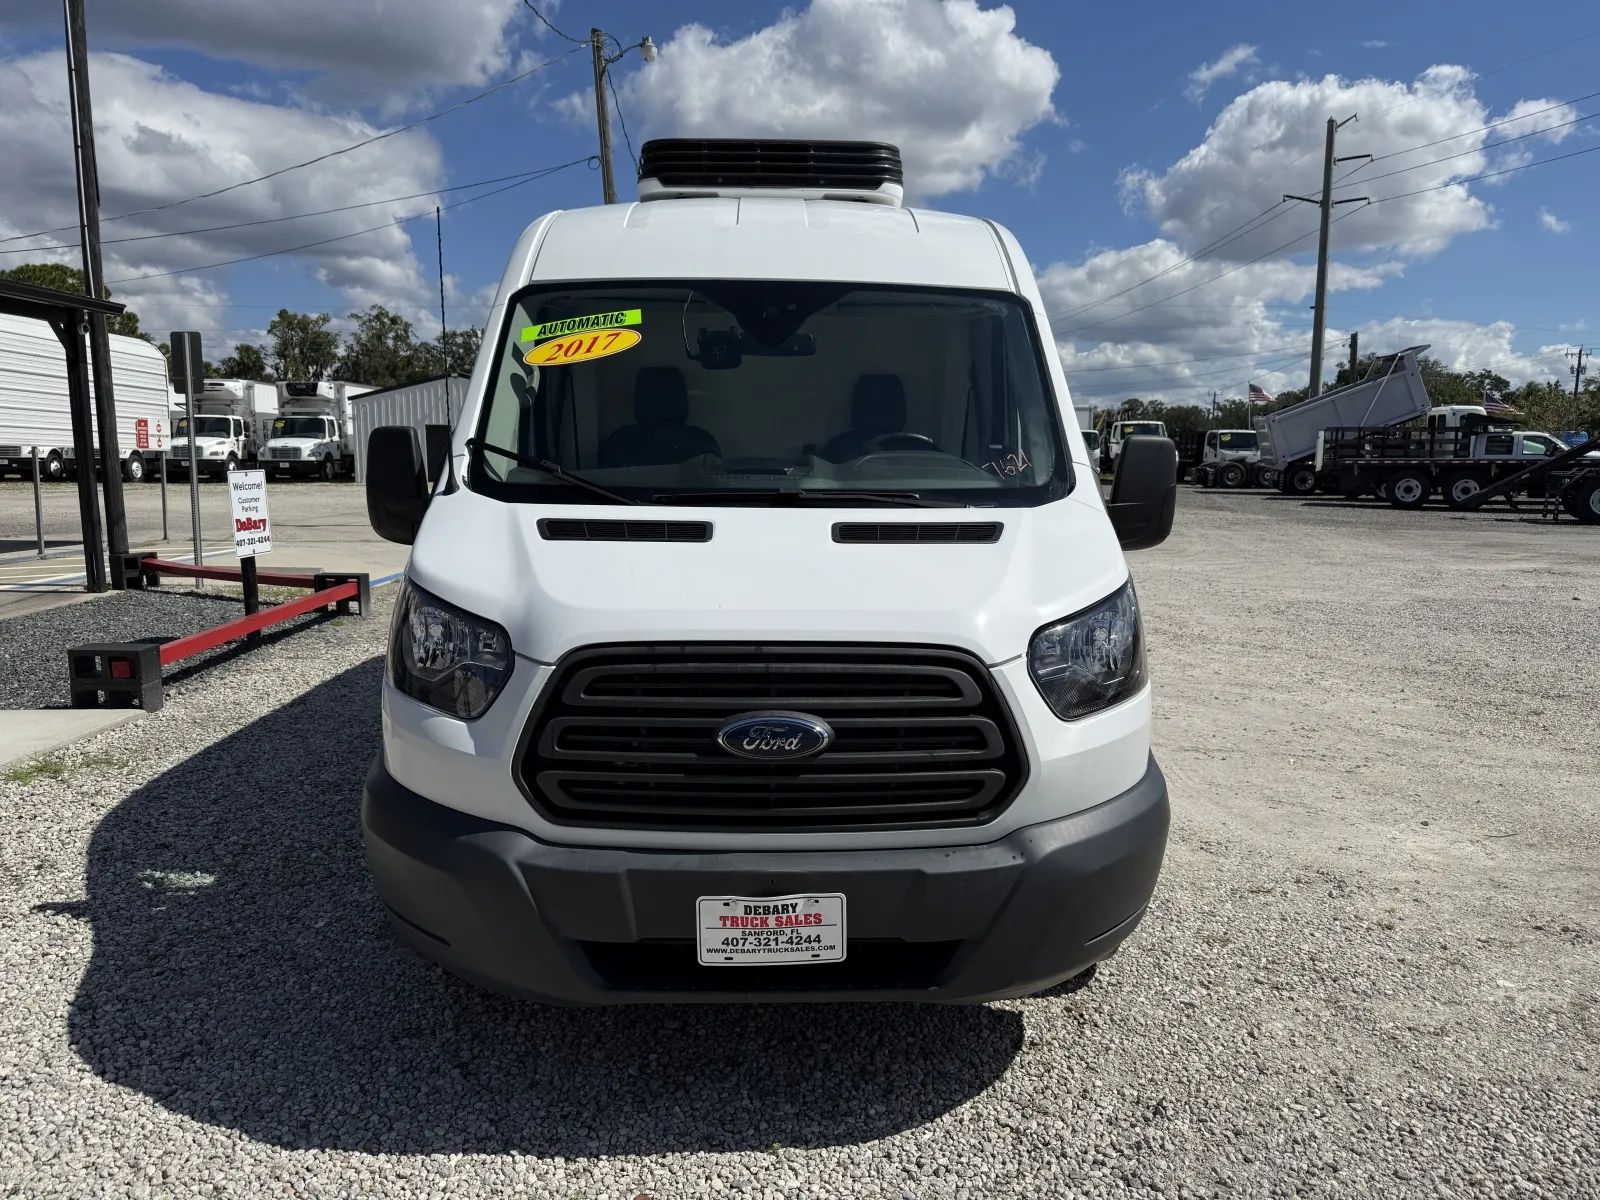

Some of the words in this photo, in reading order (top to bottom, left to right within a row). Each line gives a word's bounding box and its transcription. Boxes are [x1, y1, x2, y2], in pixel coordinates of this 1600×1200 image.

[537, 312, 626, 336] AUTOMATIC
[543, 332, 622, 362] 2017
[232, 481, 263, 491] Welcome!
[241, 505, 259, 513] Parking
[235, 517, 267, 532] DeBary
[236, 536, 270, 547] 407-321-4244
[743, 726, 804, 750] Ford
[744, 903, 798, 916] DEBARY
[719, 916, 770, 928] TRUCK
[775, 913, 823, 927] SALES
[721, 935, 822, 947] 407-321-4244
[706, 945, 836, 954] WWW.DEBARYTRUCKSALES.COM
